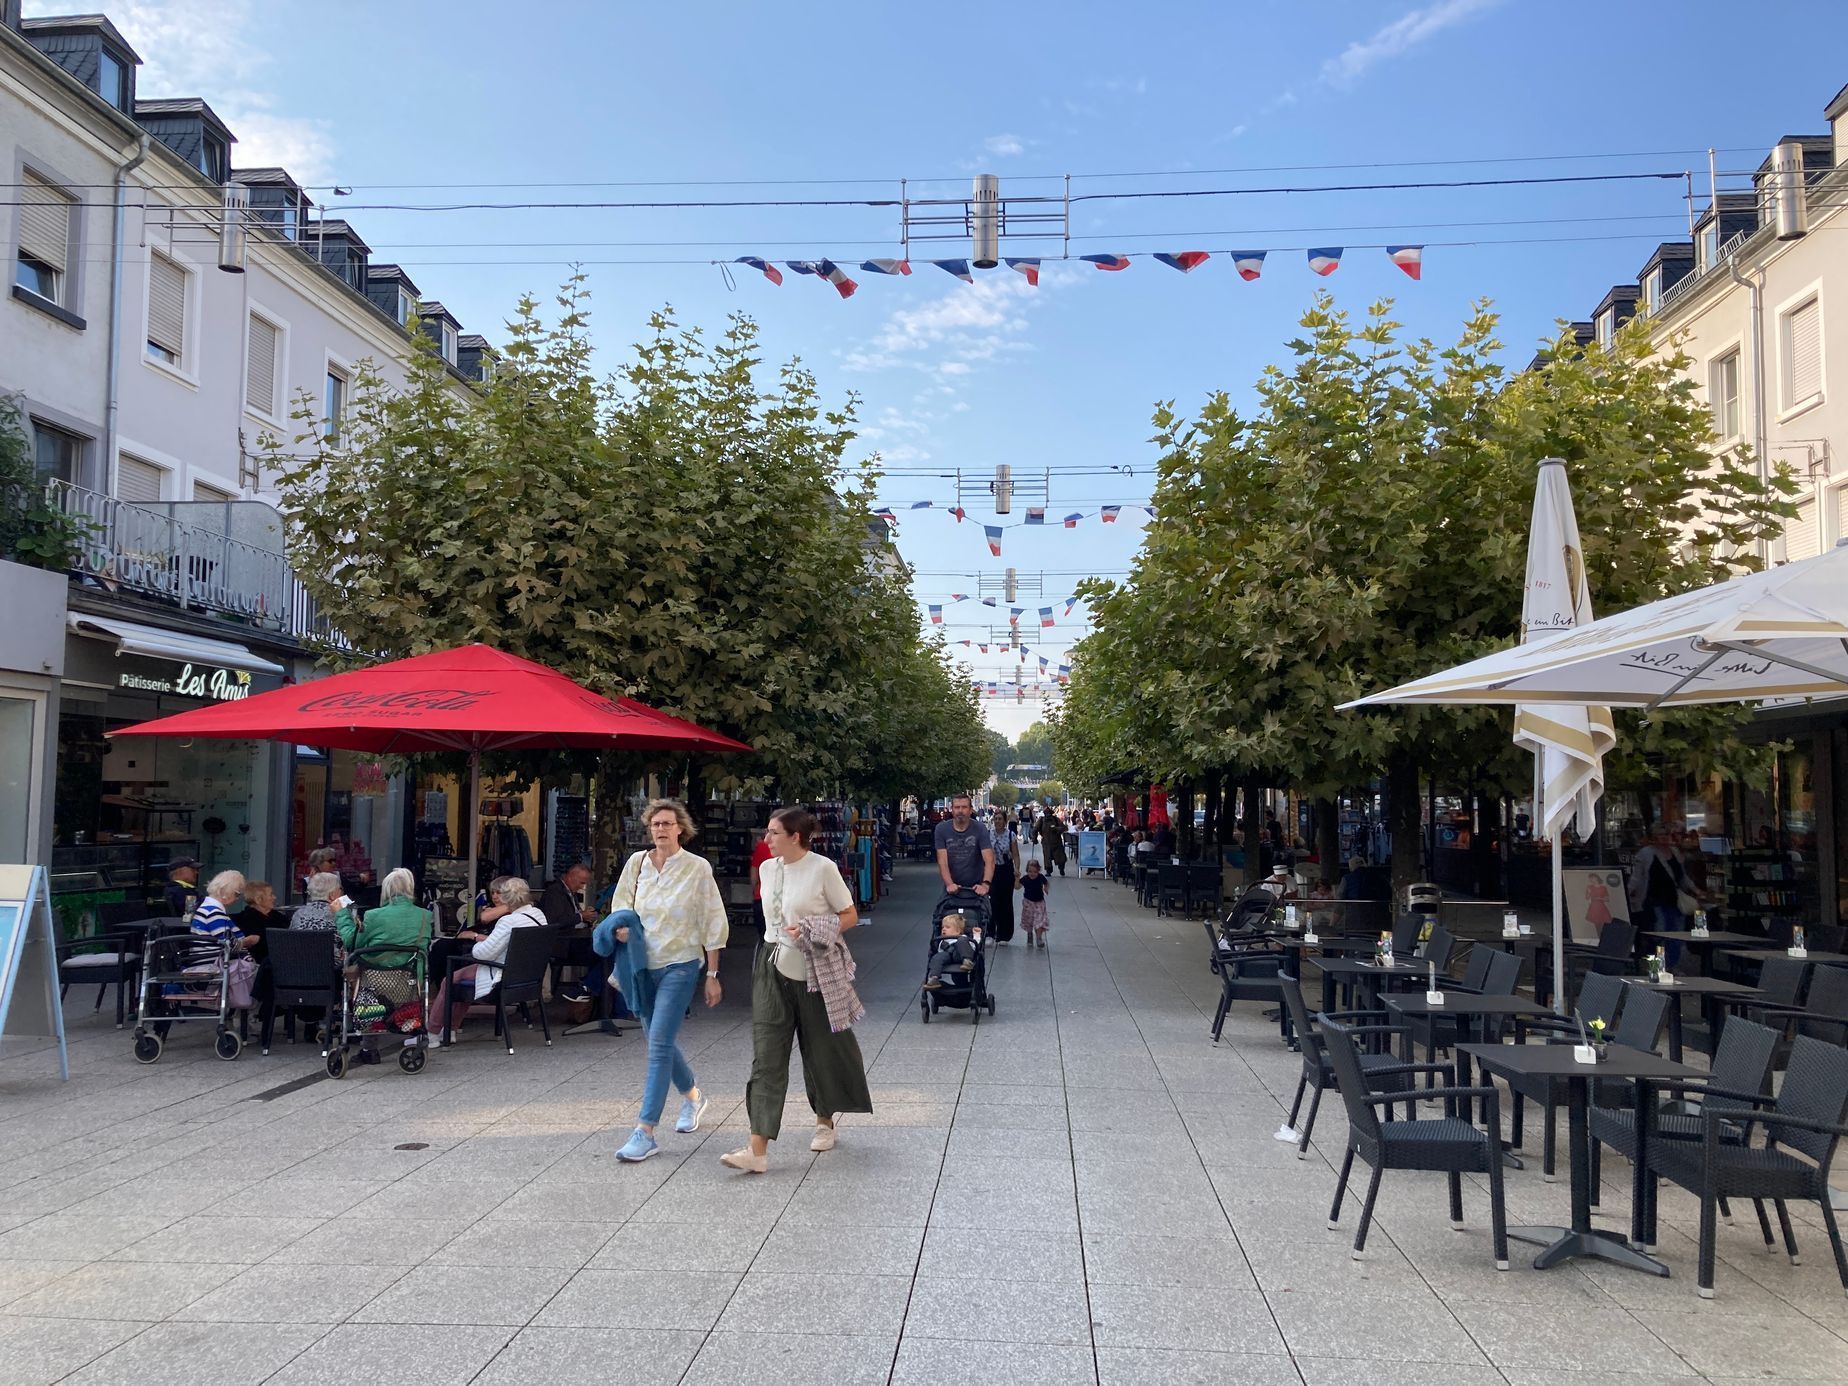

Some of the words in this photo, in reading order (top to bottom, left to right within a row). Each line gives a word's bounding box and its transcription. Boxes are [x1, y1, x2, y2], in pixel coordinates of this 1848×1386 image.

[1552, 612, 1575, 626] Bit
[176, 663, 207, 697] Les
[210, 669, 250, 701] Amis
